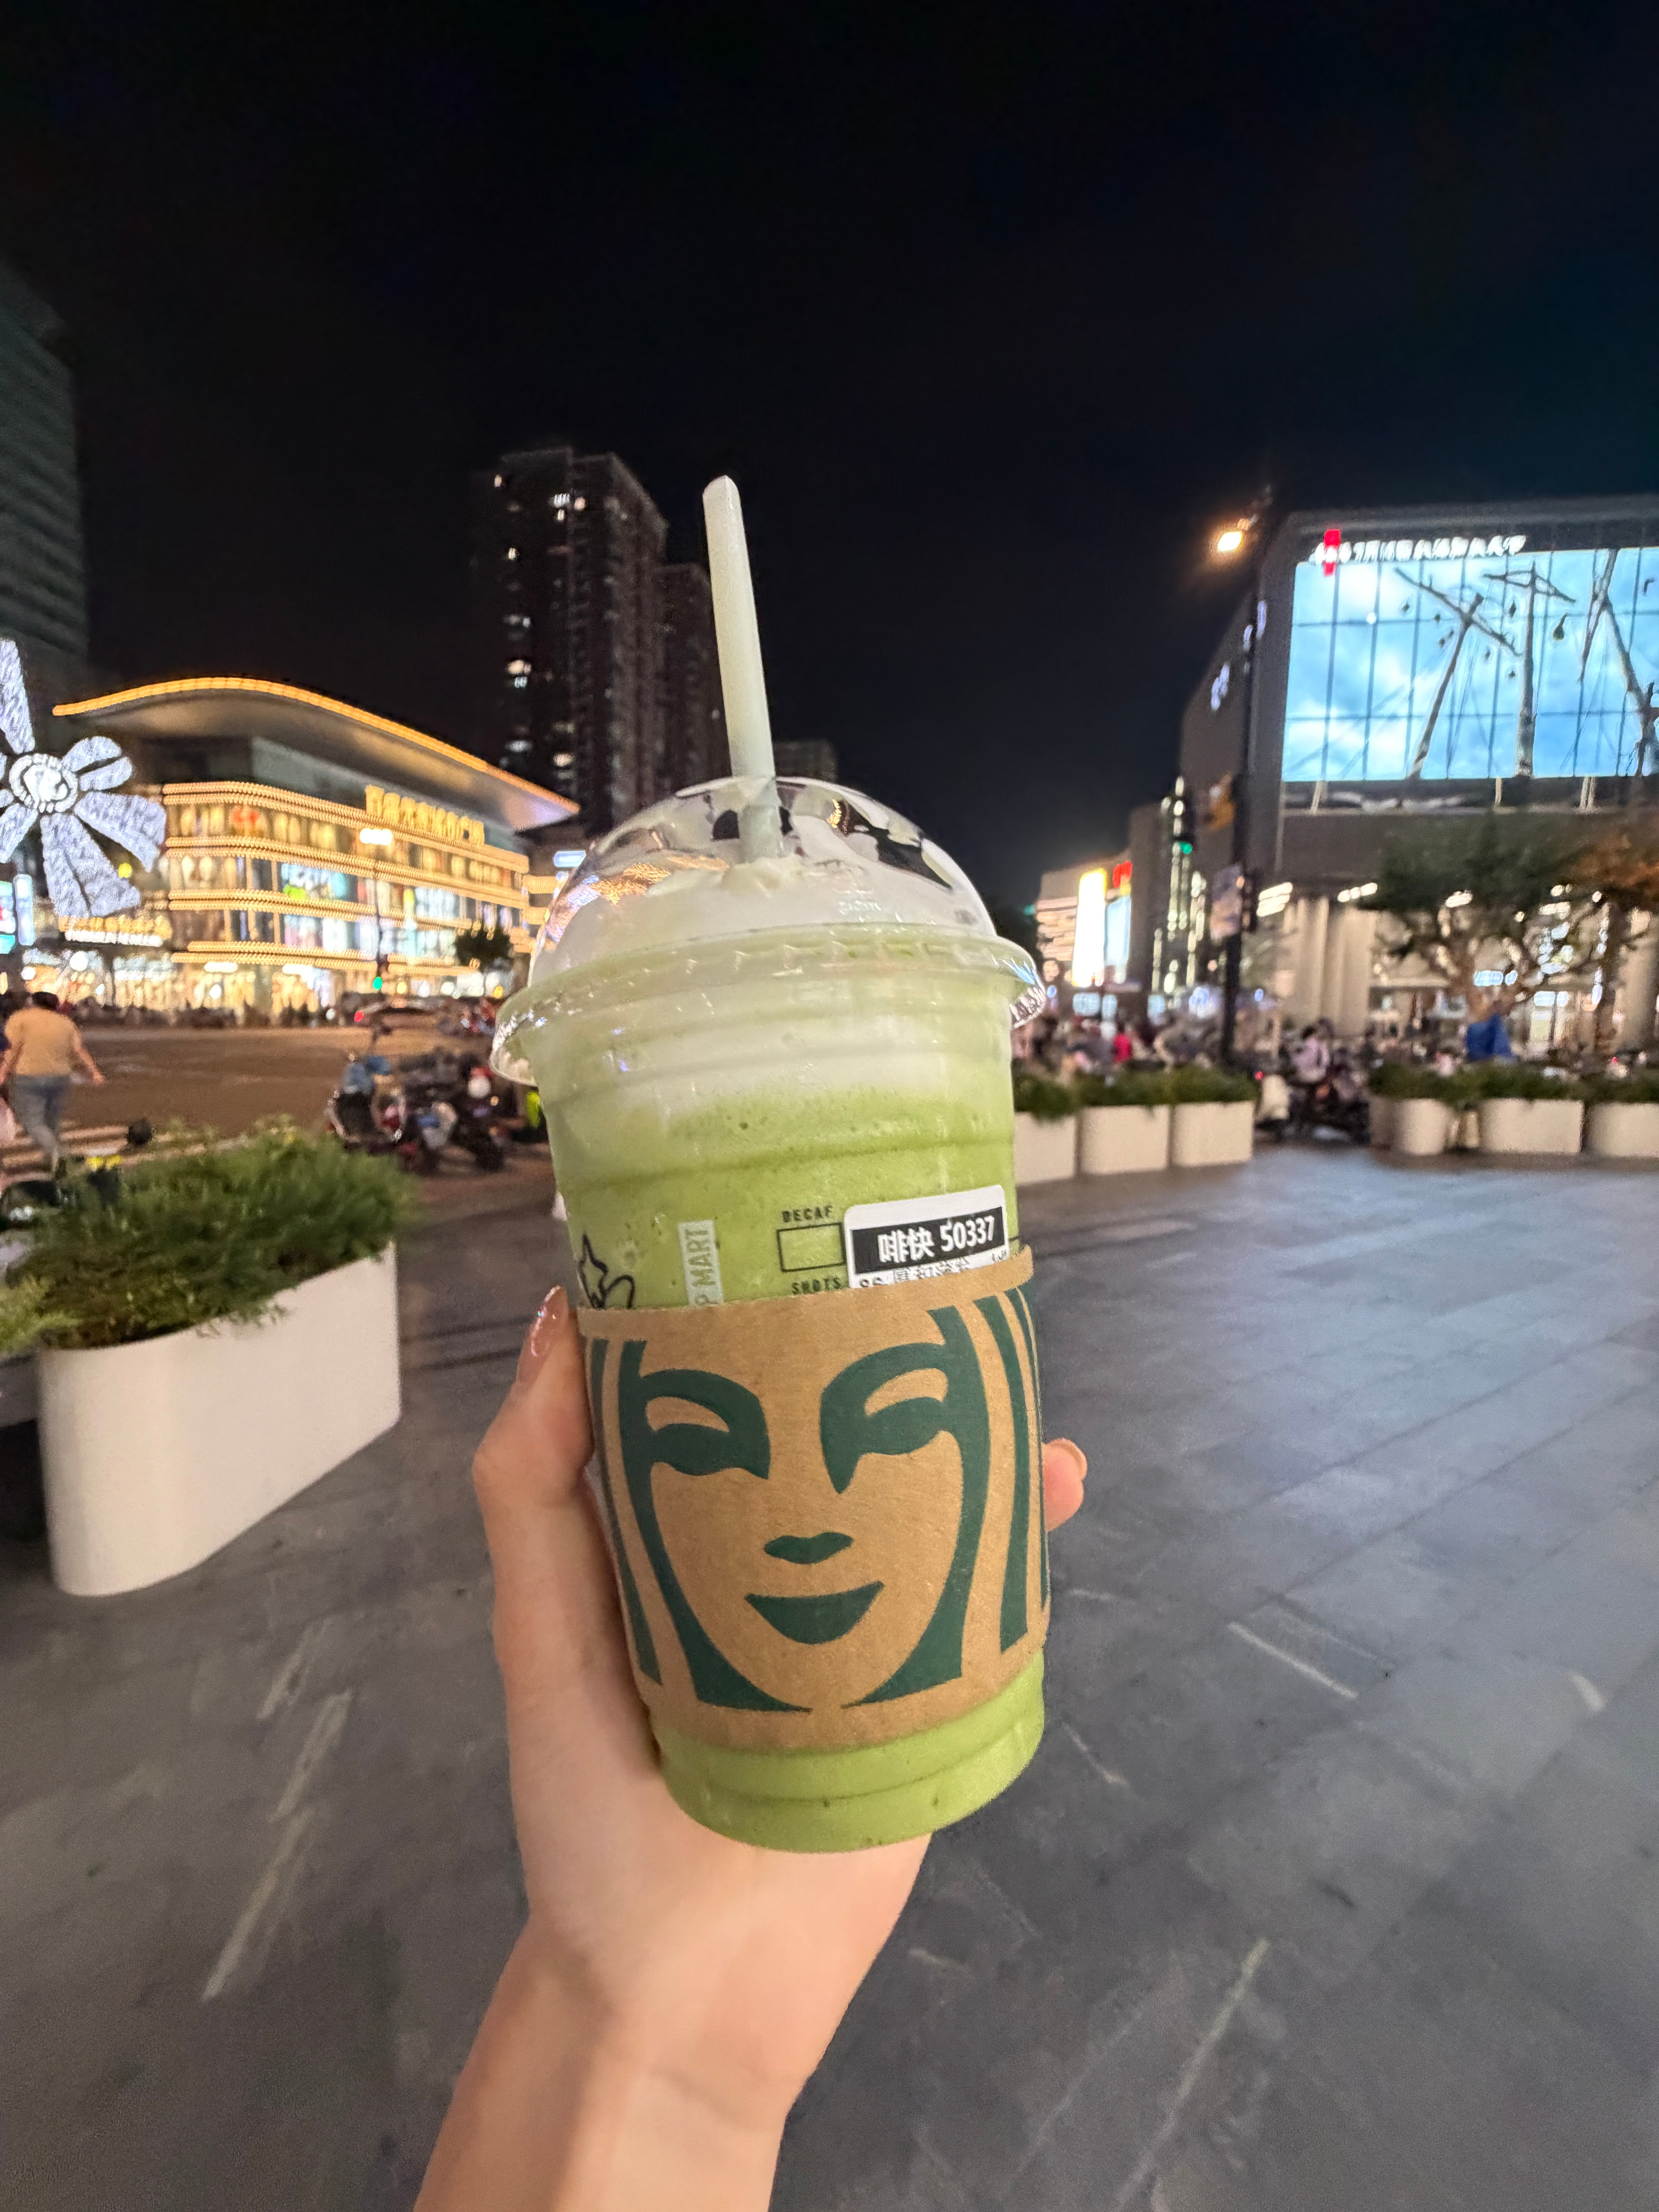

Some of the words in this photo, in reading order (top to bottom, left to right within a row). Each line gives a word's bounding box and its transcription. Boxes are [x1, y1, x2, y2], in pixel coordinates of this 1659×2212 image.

[781, 1205, 833, 1223] DECAF
[877, 1226, 935, 1263] 啡快
[939, 1215, 995, 1252] 50337
[685, 1229, 716, 1287] MART
[792, 1276, 845, 1295] SHOTS
